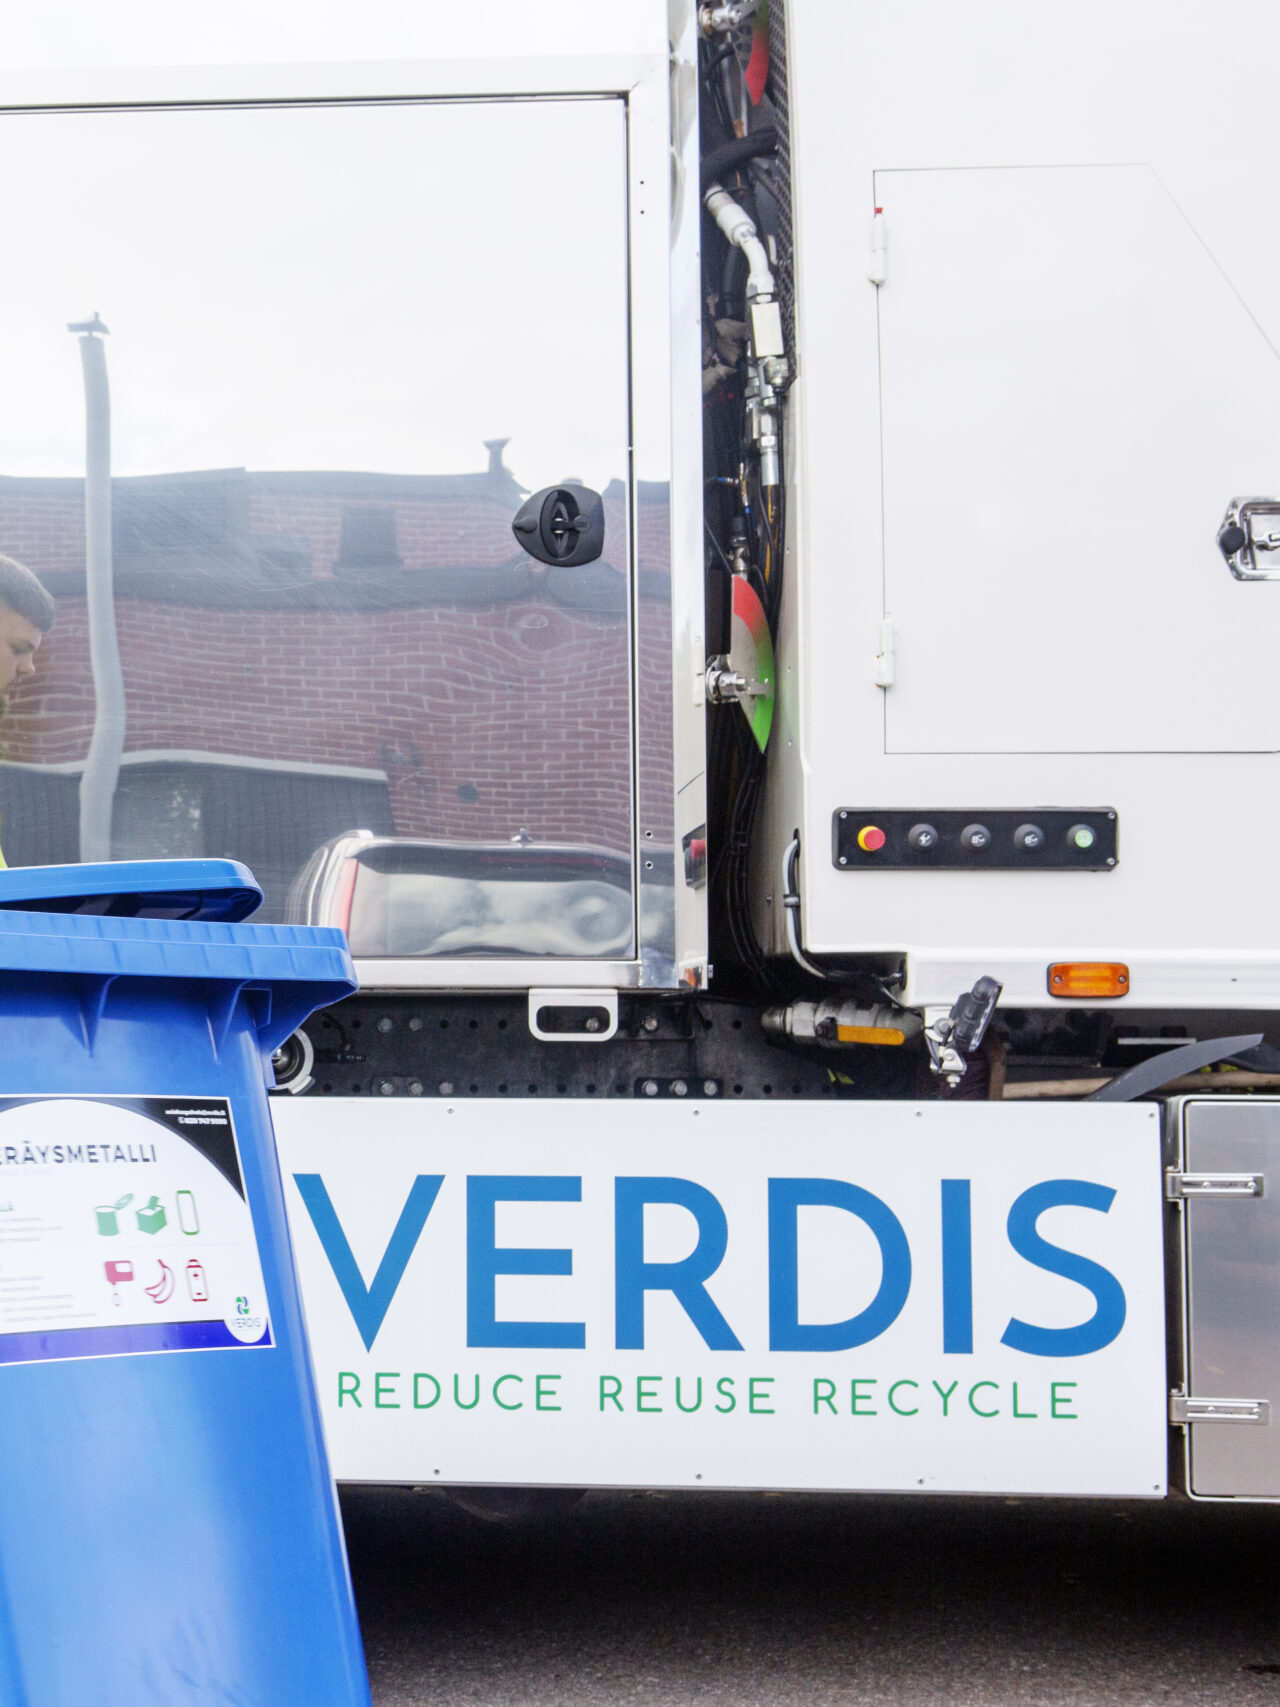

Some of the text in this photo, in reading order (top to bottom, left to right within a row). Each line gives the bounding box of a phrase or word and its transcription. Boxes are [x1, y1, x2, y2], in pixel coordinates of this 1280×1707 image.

[292, 1173, 1128, 1357] VERDIS
[337, 1371, 1079, 1420] REDUCE REUSE RECYCLE
